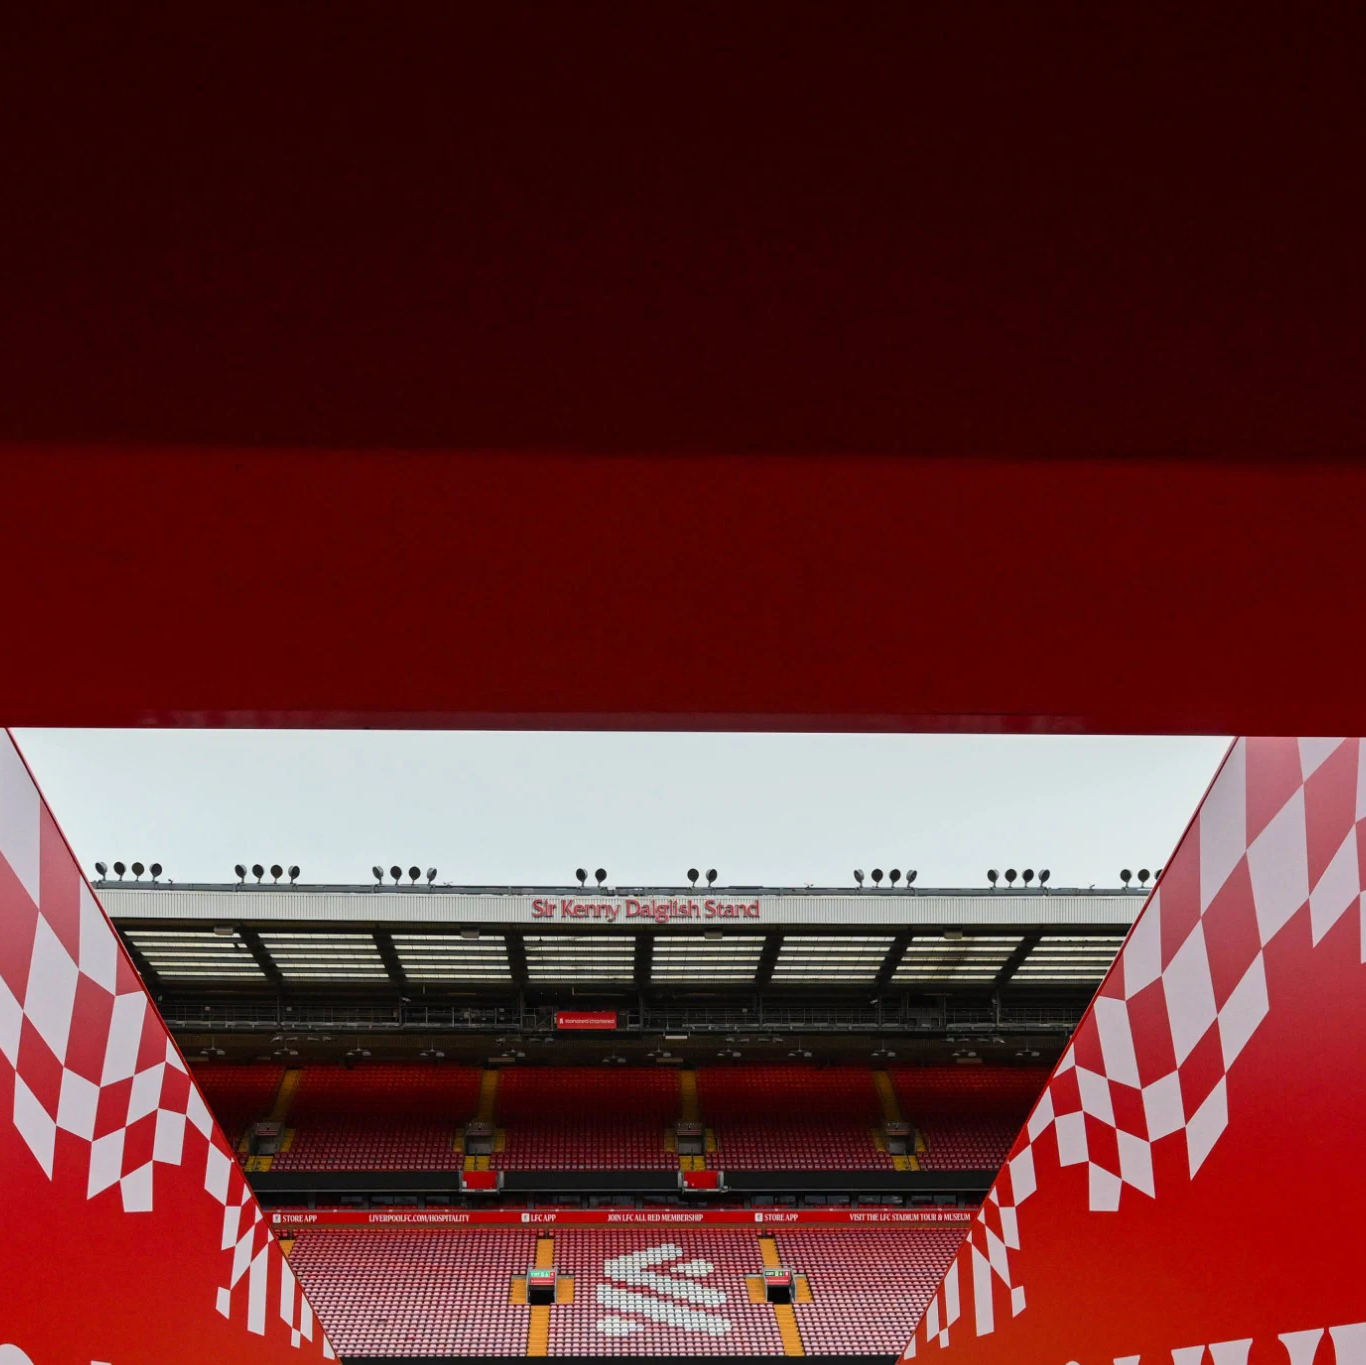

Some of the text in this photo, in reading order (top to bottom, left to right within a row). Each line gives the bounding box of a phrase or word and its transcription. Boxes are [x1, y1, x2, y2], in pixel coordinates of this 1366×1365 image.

[532, 899, 760, 923] Sir Kenny Dalglish Stand
[282, 1214, 317, 1223] STORE APP
[368, 1214, 470, 1223] LIVERPOOLFC.COM/HOSPITALITY
[531, 1214, 556, 1222] LFC APP
[607, 1213, 703, 1222] JOIN LFC ALL RED MEMBERSHIP
[764, 1213, 798, 1222] STORE APP
[849, 1213, 970, 1221] VISIT THE LFC STADIUM TOUR & MUSEUM
